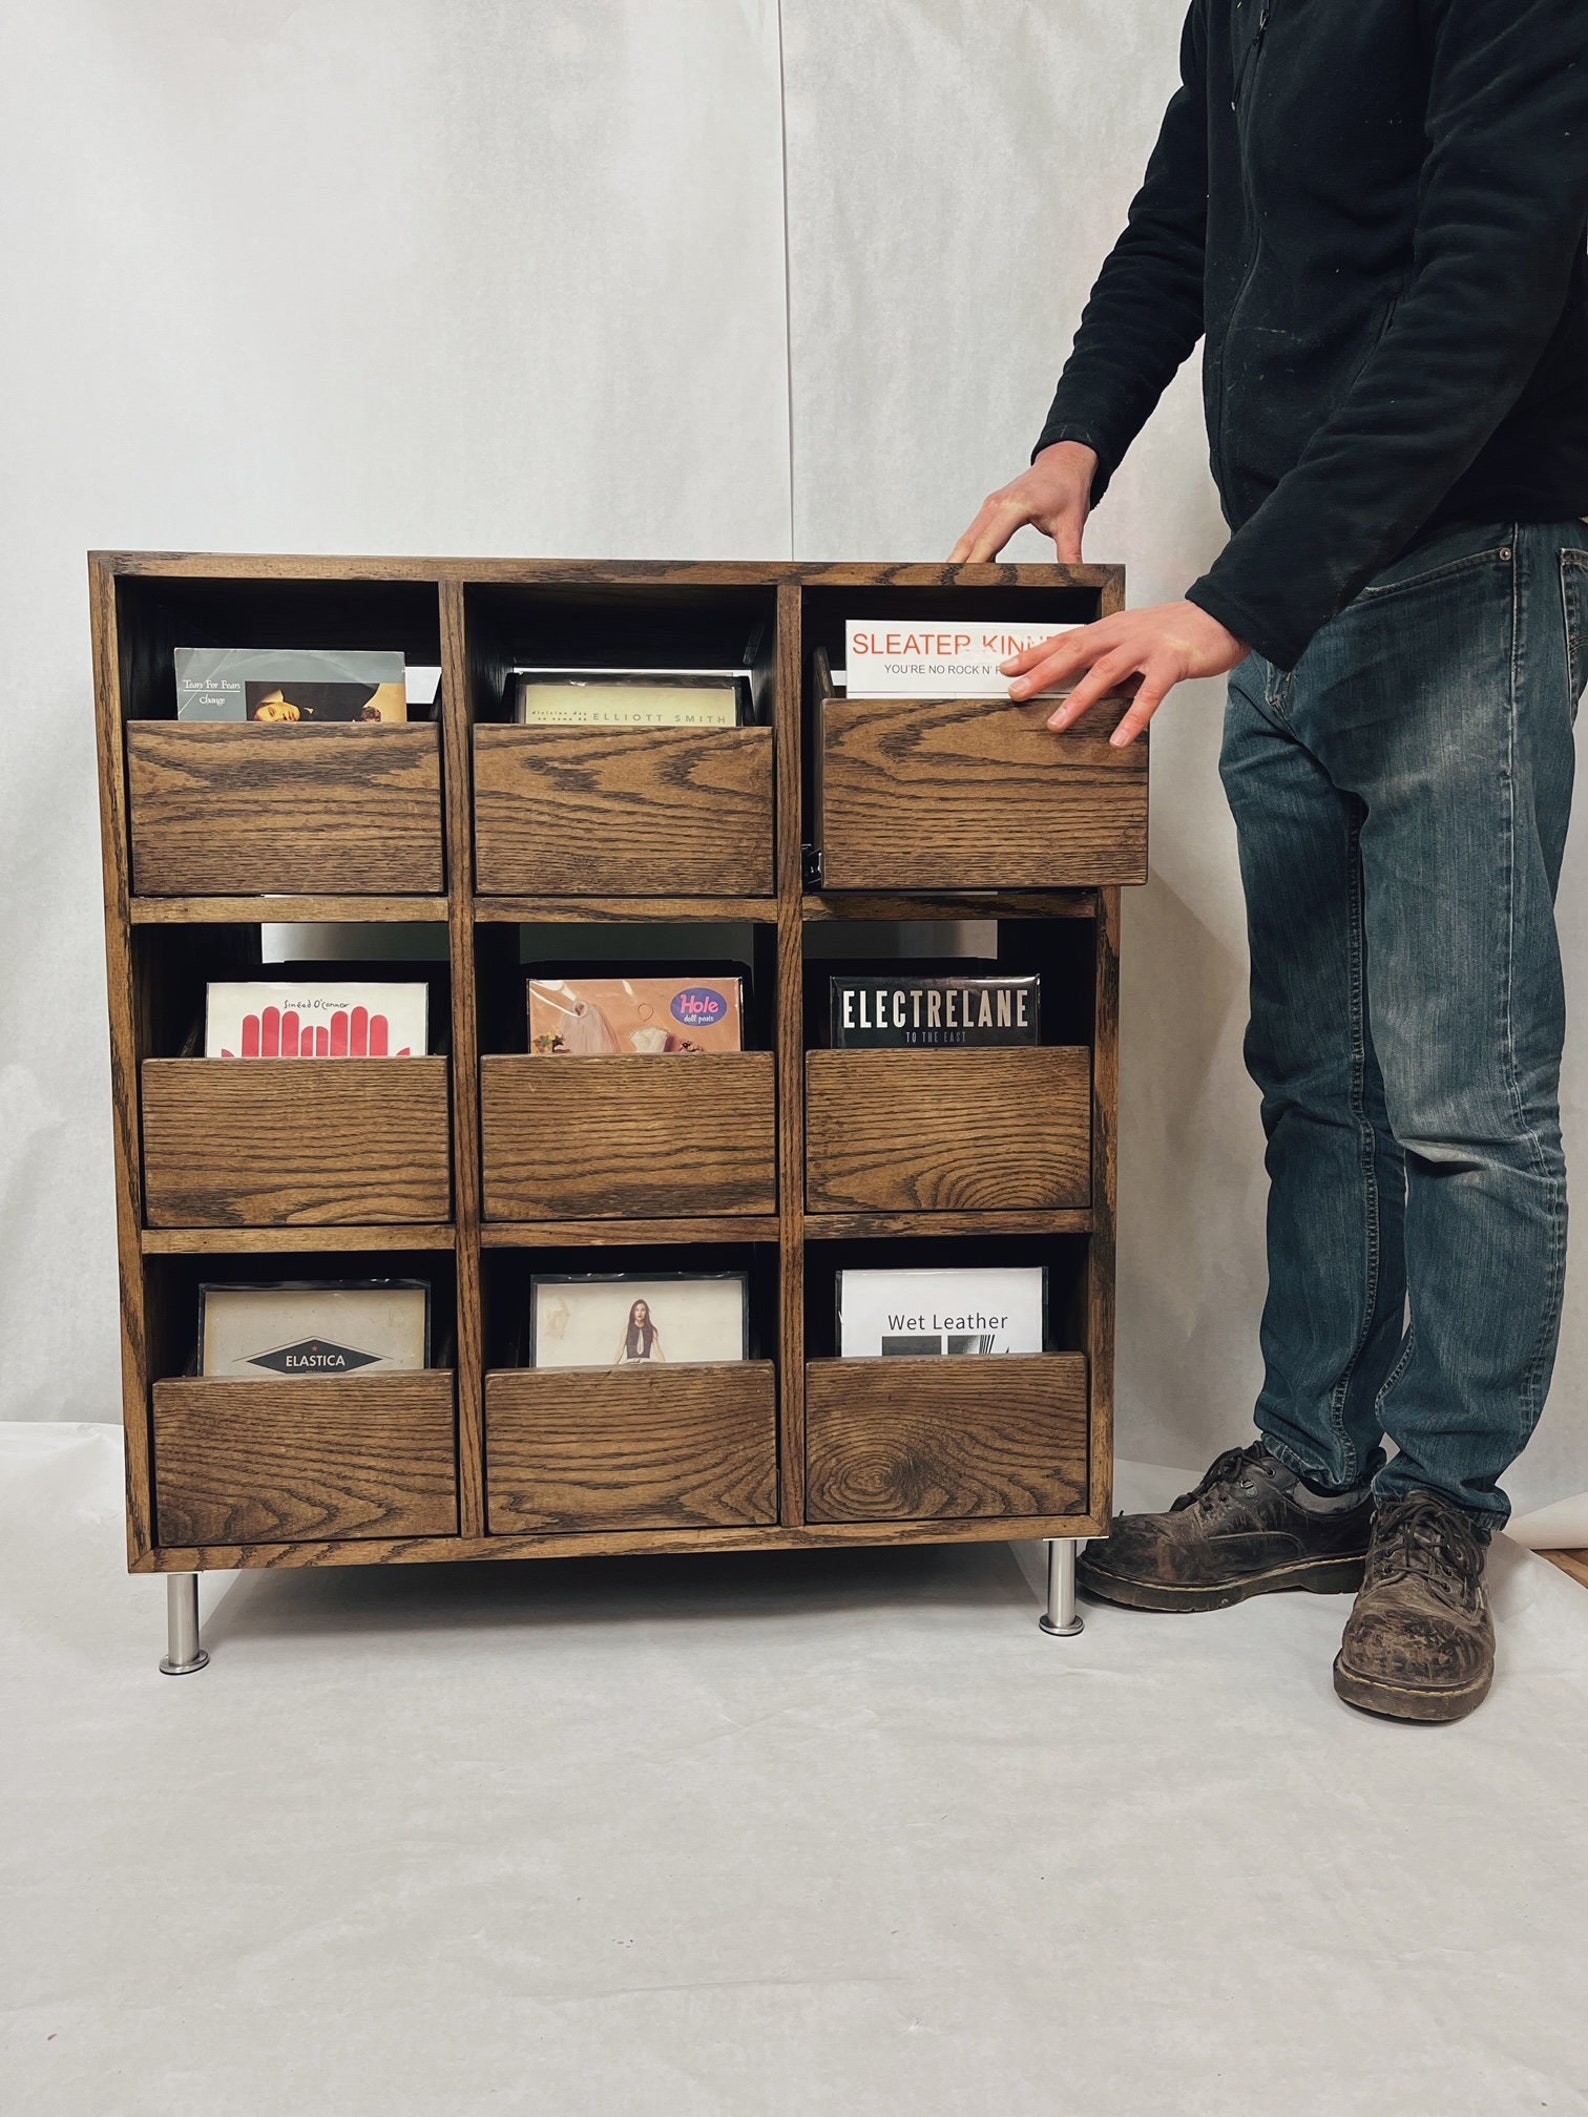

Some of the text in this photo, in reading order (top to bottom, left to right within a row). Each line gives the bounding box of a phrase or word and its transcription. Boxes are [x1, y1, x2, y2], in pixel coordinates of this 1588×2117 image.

[884, 664, 926, 674] YOU'RE
[928, 665, 945, 674] NO
[948, 665, 980, 675] ROCK
[183, 679, 241, 690] Tears For Fears
[592, 712, 663, 722] ELLIOTT
[674, 714, 726, 723] SMITH
[680, 994, 719, 1013] Hole
[842, 989, 1029, 1028] ELECTRELANE
[684, 1013, 698, 1023] doll
[905, 1031, 967, 1043] TO THE EAST
[887, 1312, 1009, 1331] Wet Leather
[285, 1354, 346, 1367] ELASTICA
